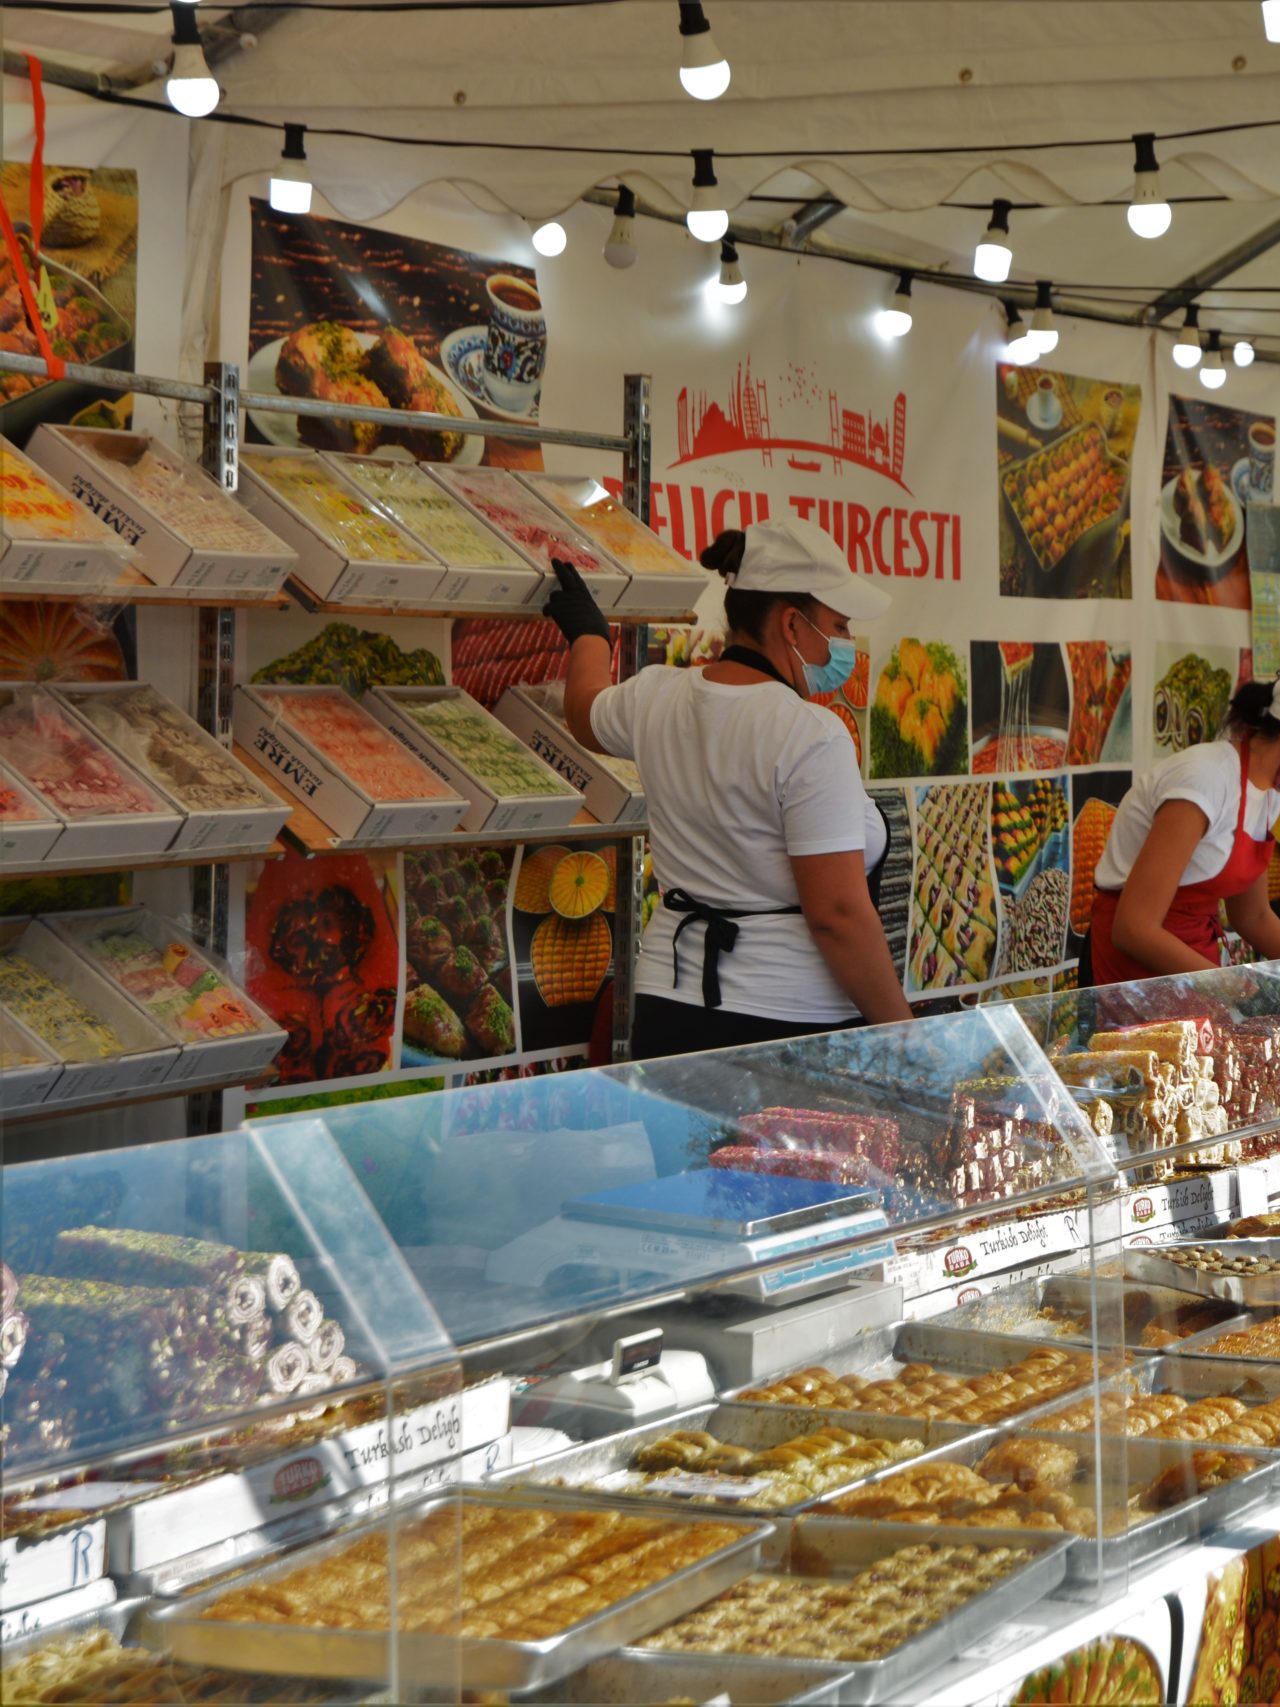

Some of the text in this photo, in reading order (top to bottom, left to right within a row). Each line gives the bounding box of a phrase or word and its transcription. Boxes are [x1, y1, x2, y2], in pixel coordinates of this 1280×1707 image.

[254, 733, 319, 797] EMRE
[529, 735, 588, 792] EMRE
[946, 1248, 970, 1265] TURKO
[980, 1220, 1049, 1256] Turkish Delight
